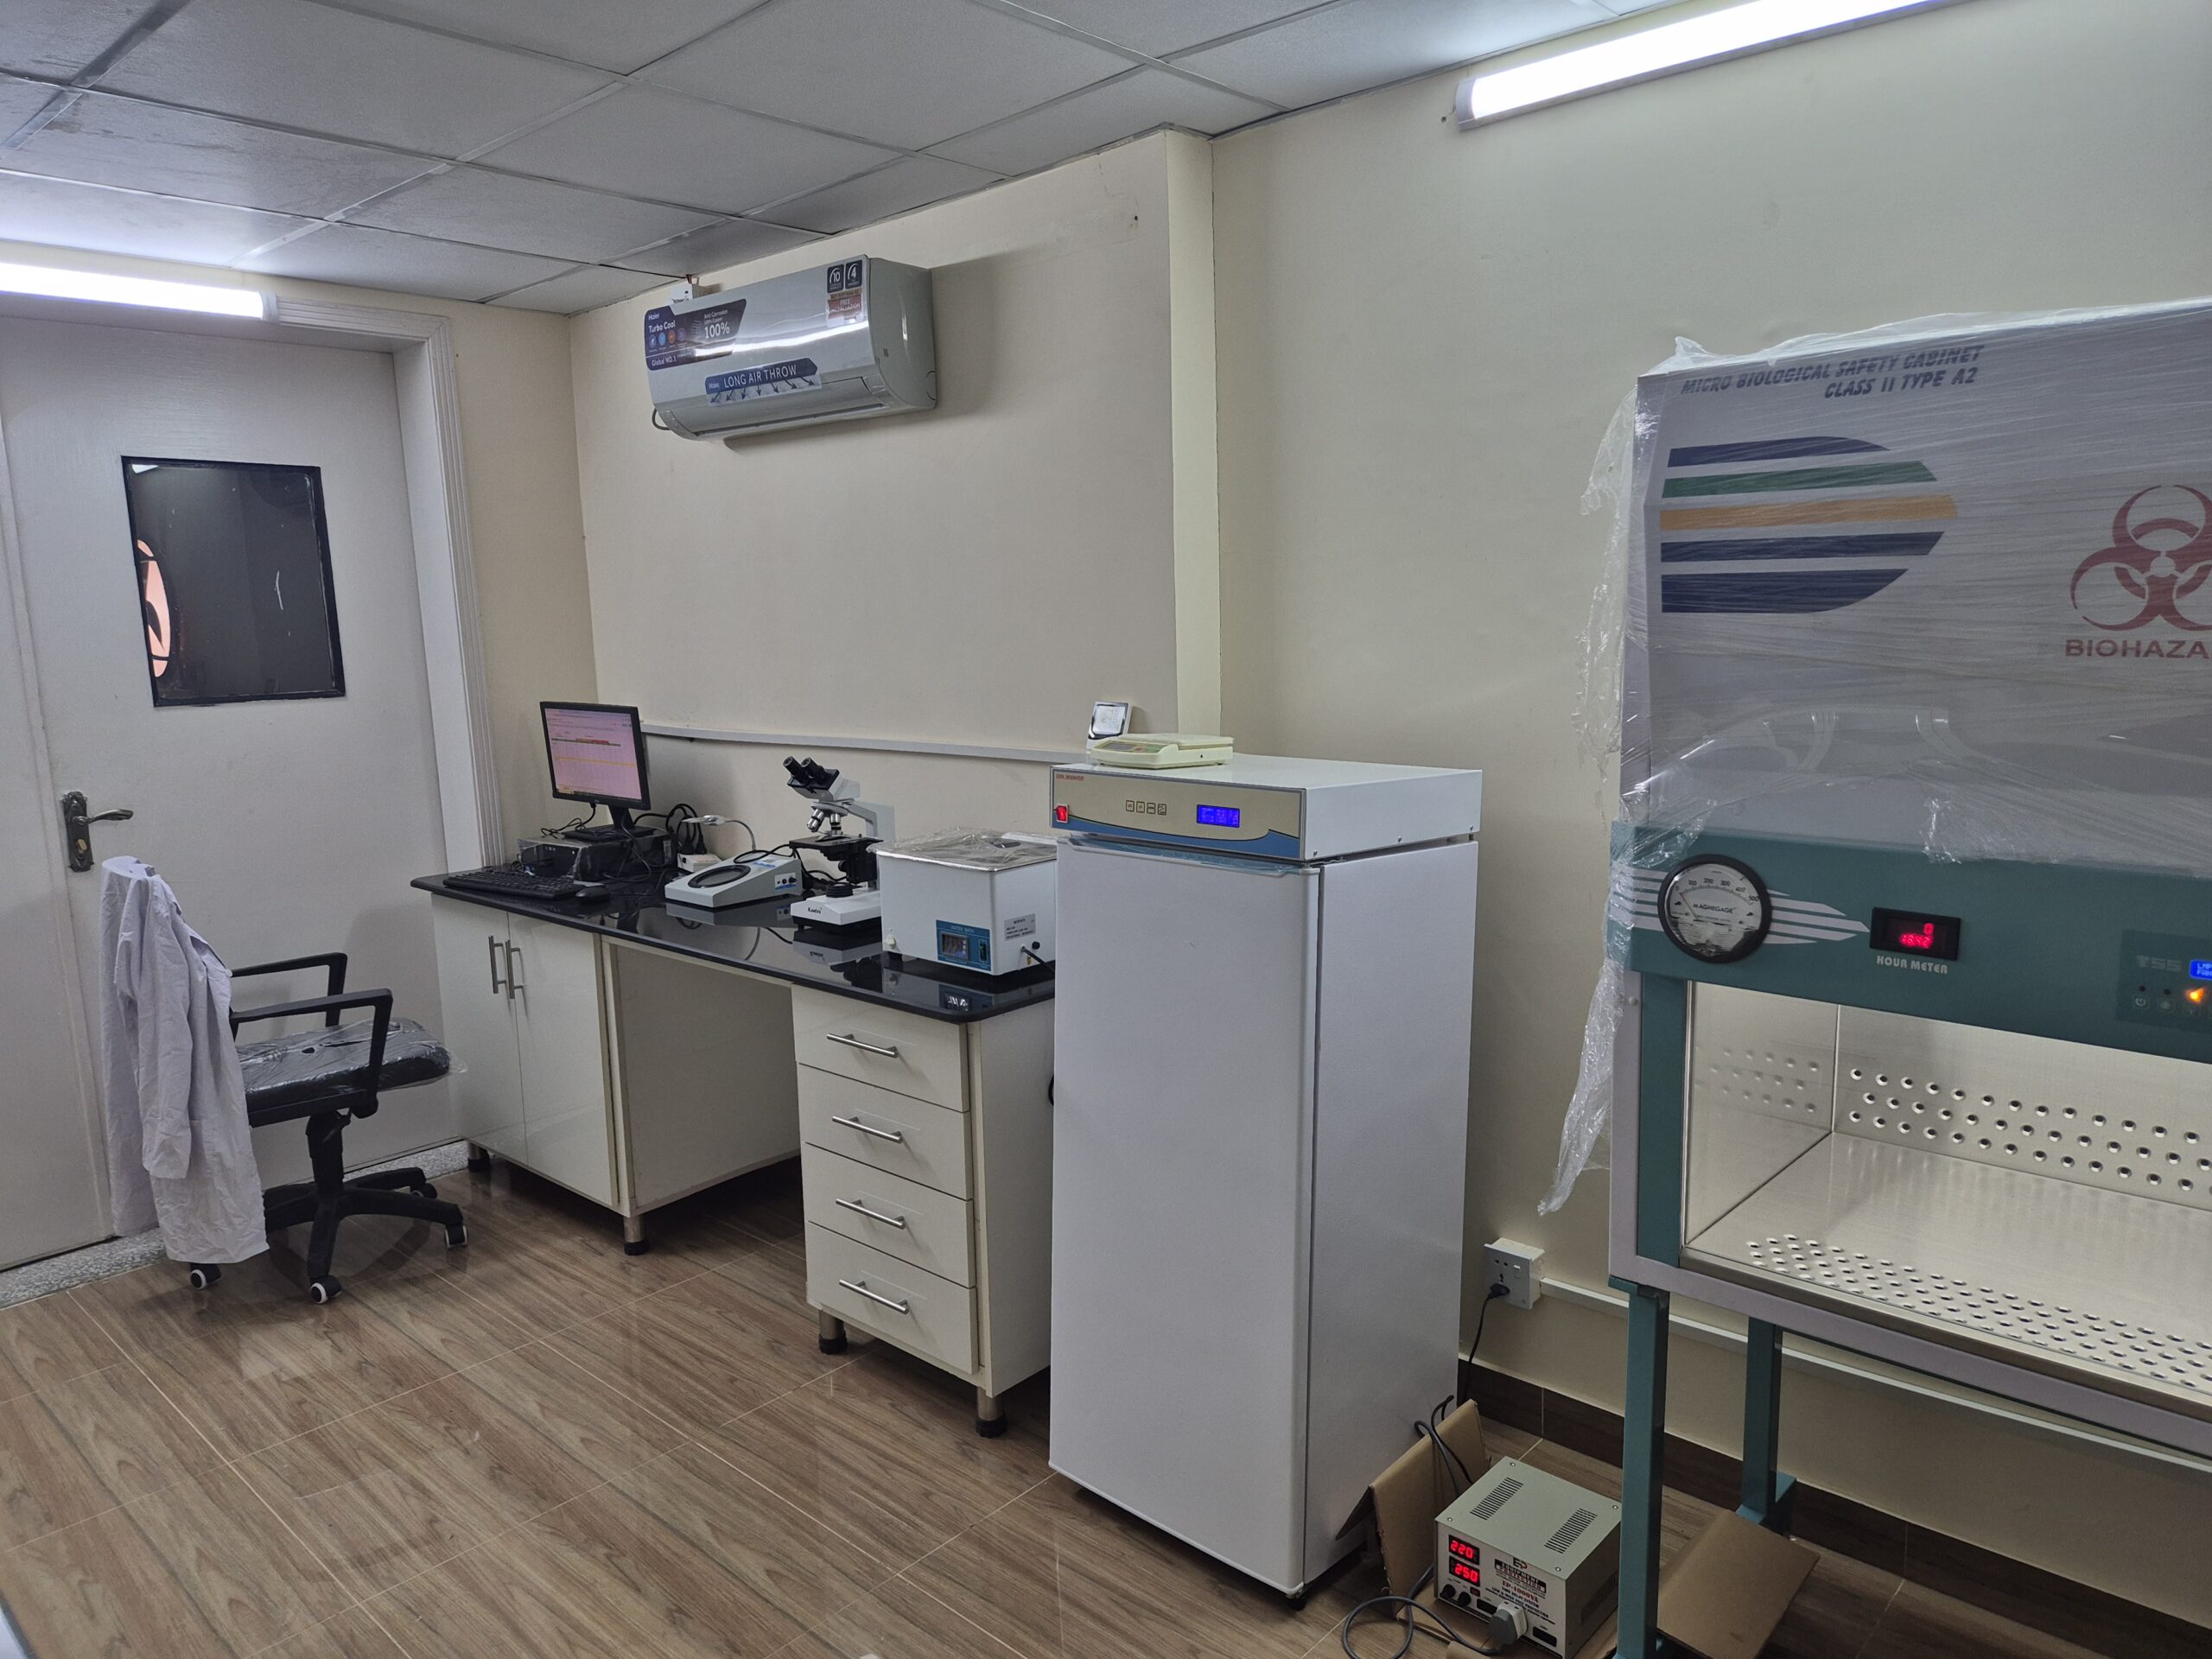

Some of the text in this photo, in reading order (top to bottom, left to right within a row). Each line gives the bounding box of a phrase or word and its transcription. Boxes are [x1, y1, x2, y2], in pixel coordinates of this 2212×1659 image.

[649, 321, 676, 334] Turbo Cool
[705, 323, 730, 339] 100%
[652, 358, 665, 366] Global
[1681, 346, 1985, 394] MICRO BIOLOGICAL SAFETY CABINET
[724, 365, 796, 388] LONG AIR THROW
[1825, 378, 1876, 398] CLASS
[1901, 371, 1946, 390] TYPE
[1951, 367, 1978, 385] A2
[2065, 639, 2212, 659] BIOHAZA
[1876, 956, 1948, 974] HOUR METER
[1451, 1540, 1473, 1559] 220
[1455, 1563, 1478, 1582] 250
